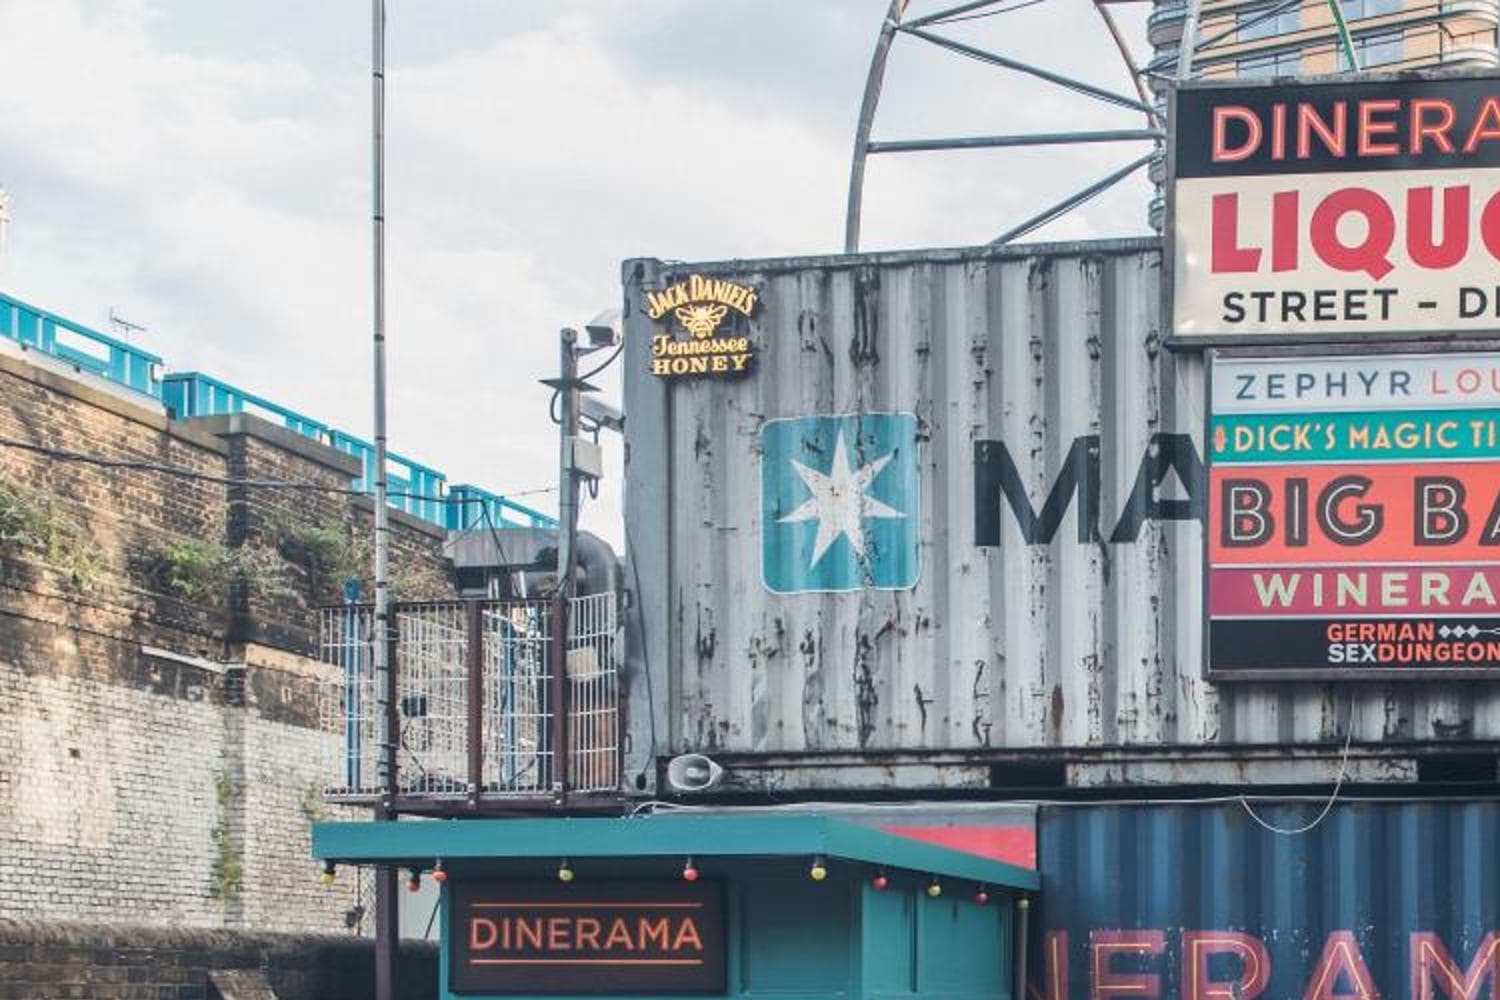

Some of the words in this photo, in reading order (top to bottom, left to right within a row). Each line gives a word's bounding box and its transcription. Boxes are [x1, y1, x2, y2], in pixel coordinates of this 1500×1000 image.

[647, 282, 689, 319] JACK
[1222, 288, 1398, 323] STREET
[652, 335, 748, 357] Tennessee
[652, 353, 753, 375] HONEY
[1235, 371, 1411, 401] ZEPHYR
[1233, 419, 1338, 452] DICK'S
[1349, 416, 1459, 449] MAGIC
[1220, 475, 1384, 549] BIG
[1327, 623, 1435, 643] GERMAN
[469, 917, 704, 951] DINERAMA
